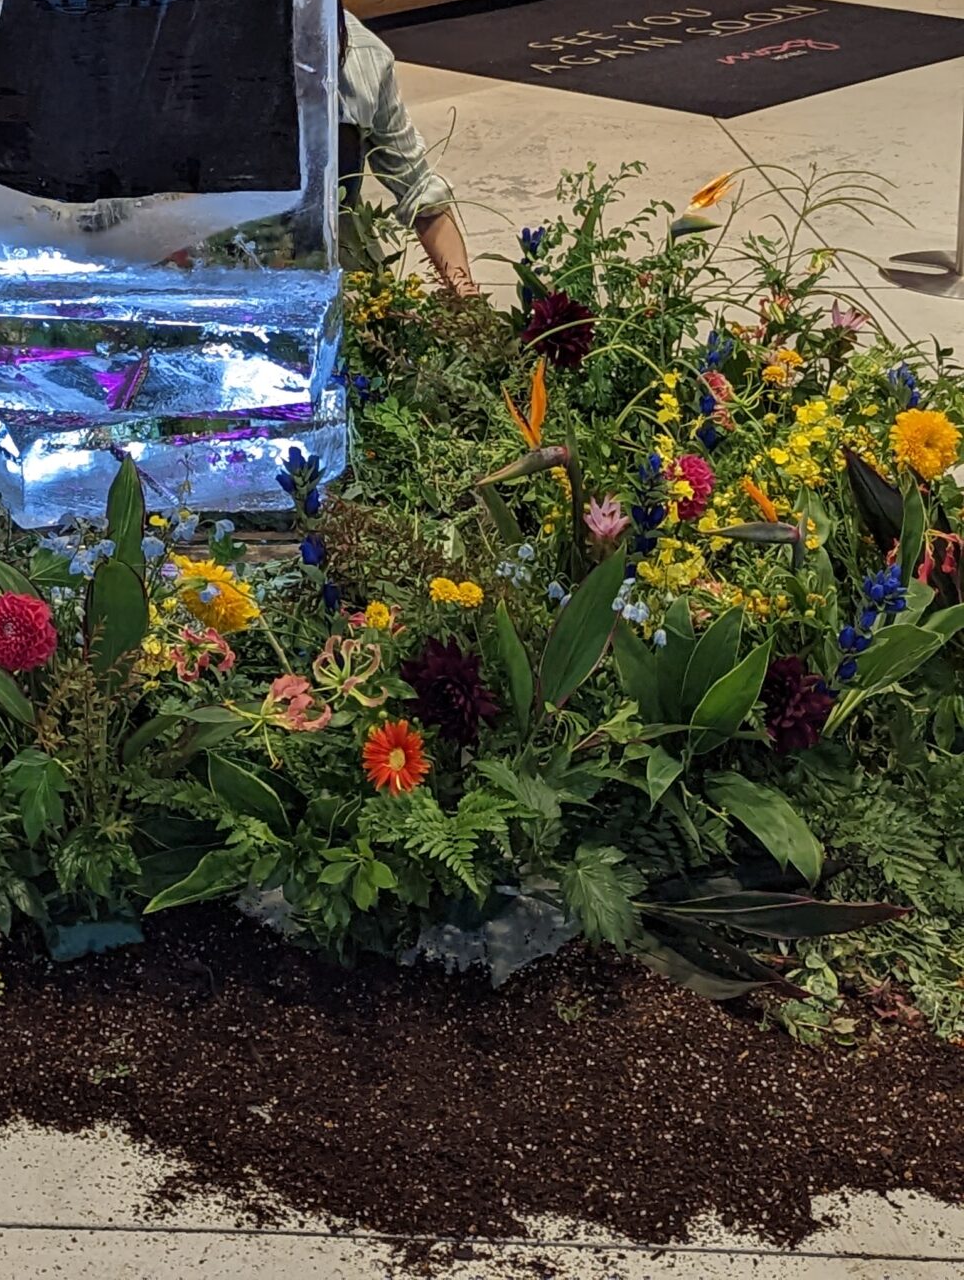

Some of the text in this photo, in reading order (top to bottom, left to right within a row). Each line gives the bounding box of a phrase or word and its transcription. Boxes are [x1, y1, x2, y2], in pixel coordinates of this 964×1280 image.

[528, 8, 712, 52] SEE YOU
[530, 4, 818, 74] AGAIN SOON
